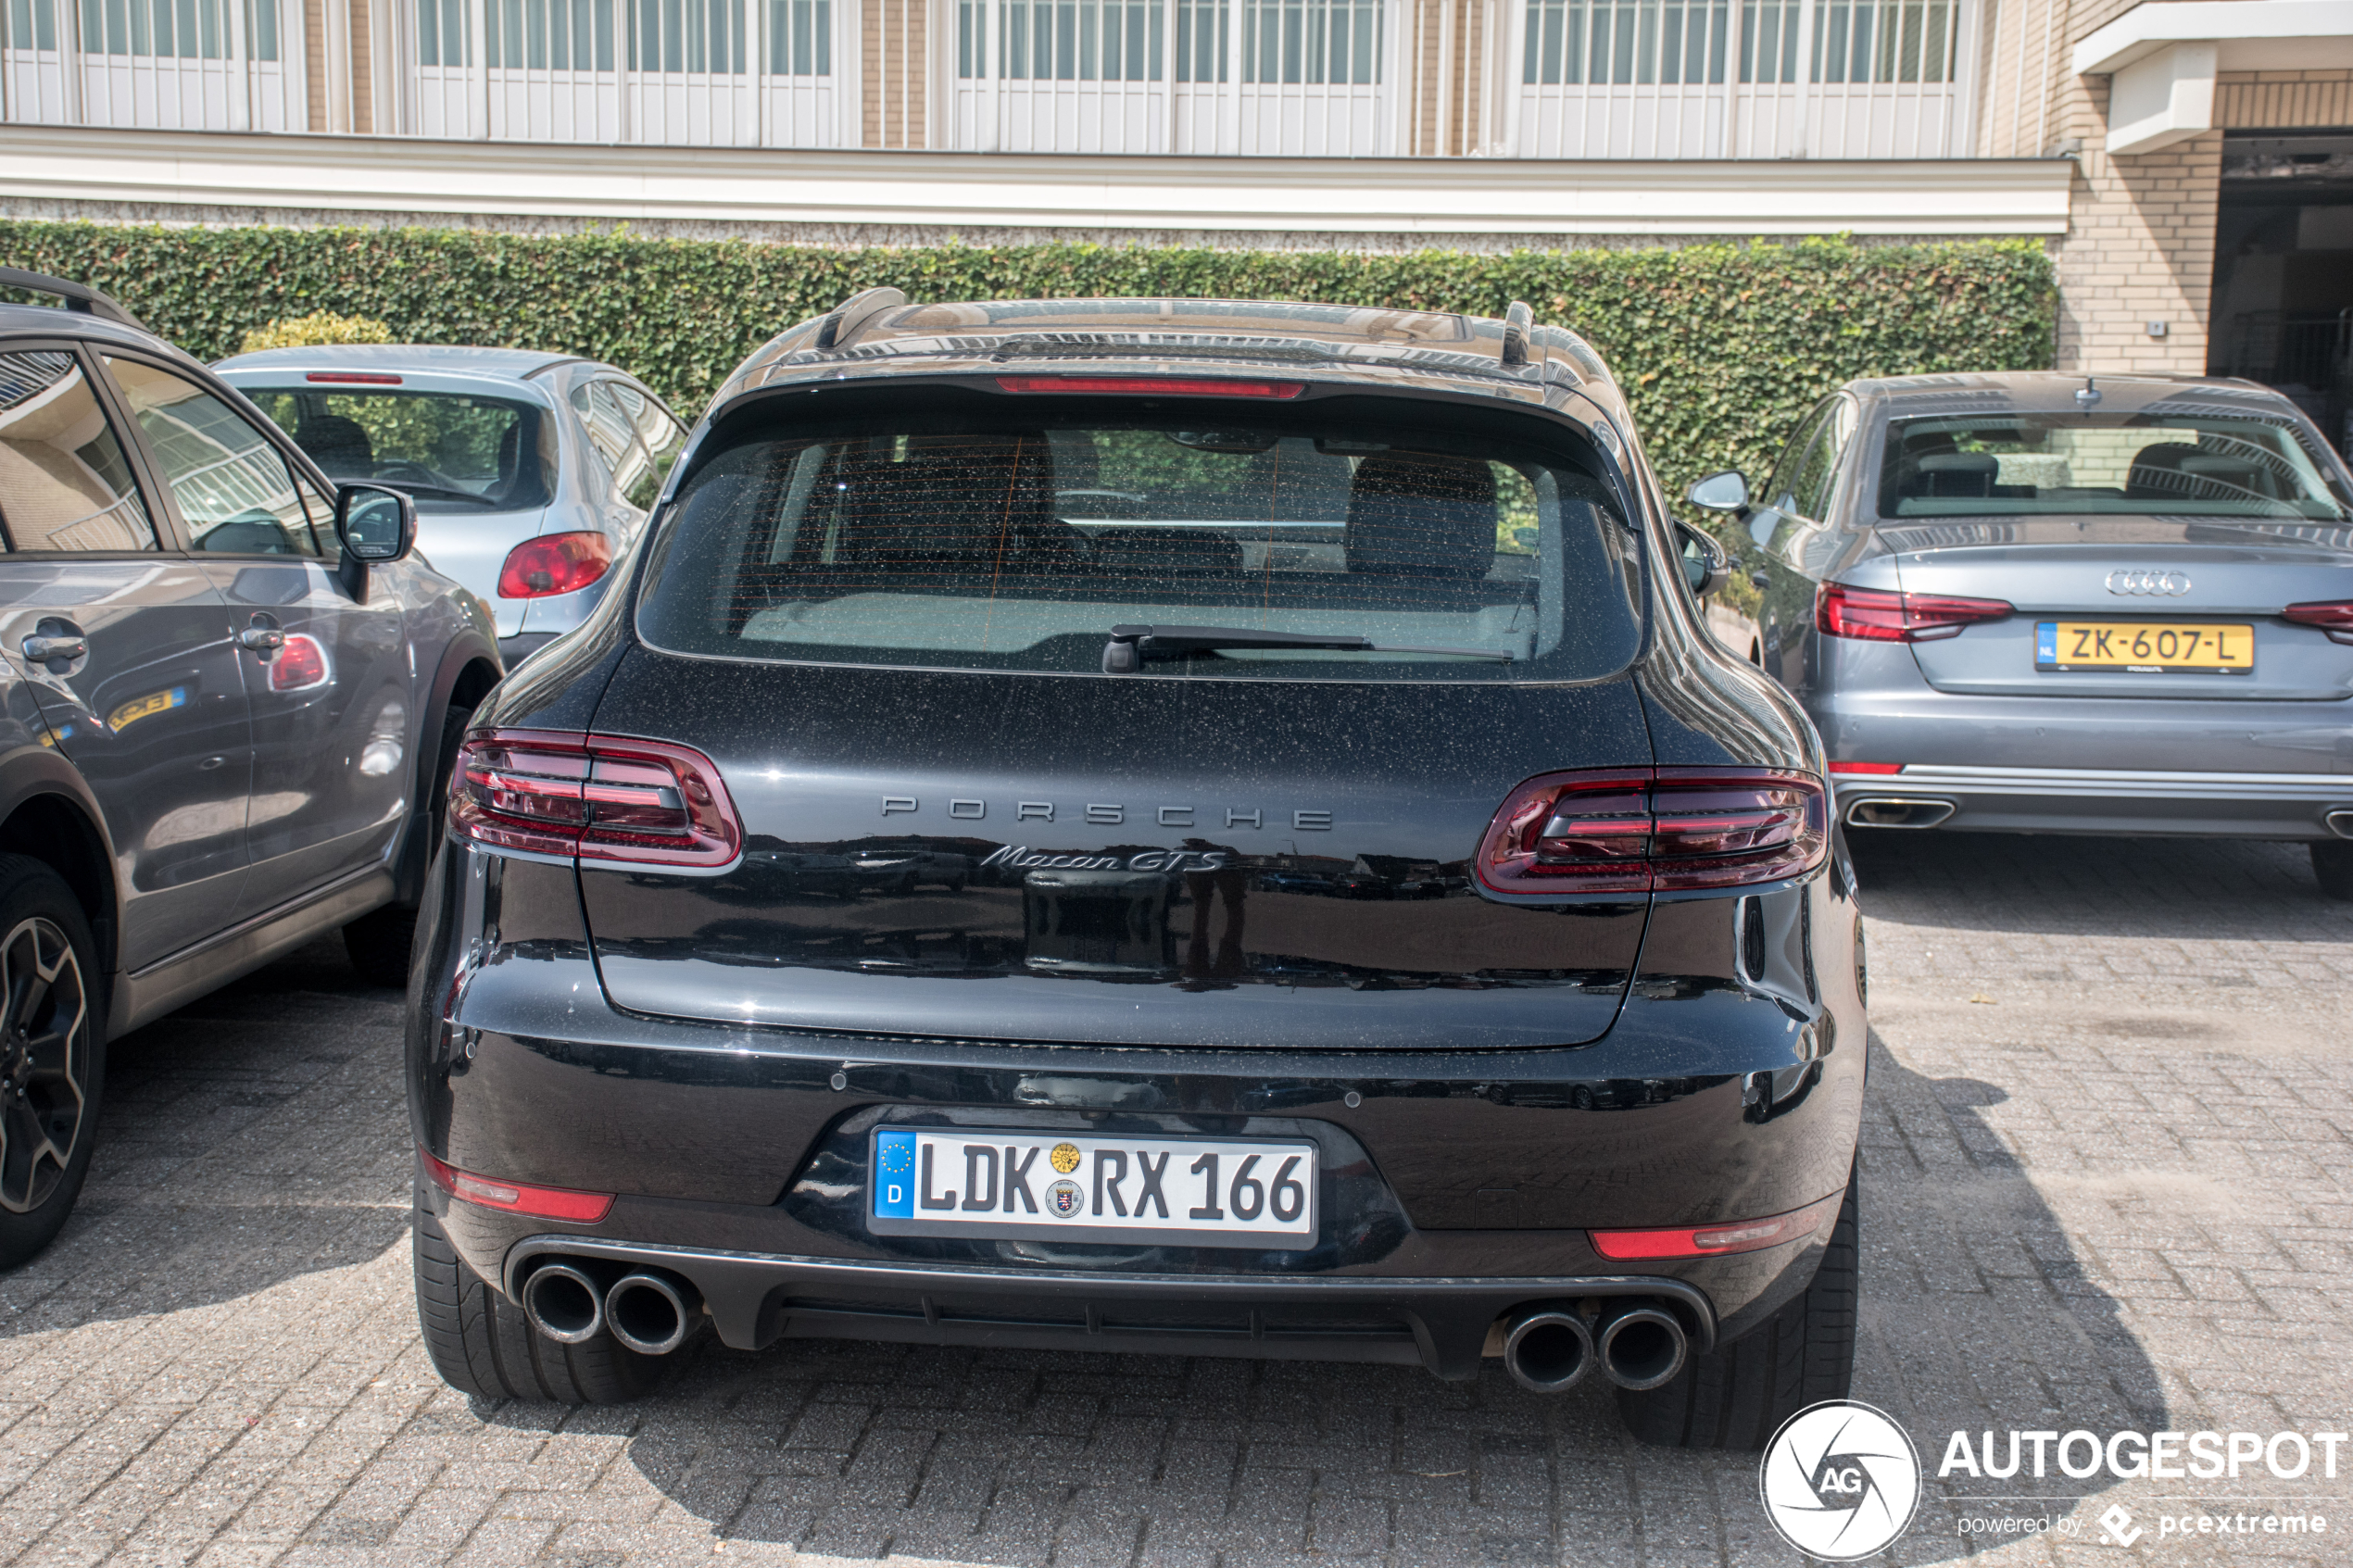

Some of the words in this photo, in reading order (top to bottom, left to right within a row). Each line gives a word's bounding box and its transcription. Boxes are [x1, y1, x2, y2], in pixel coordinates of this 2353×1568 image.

[2039, 646, 2056, 657] NL
[2071, 629, 2235, 659] ZK-607-L
[881, 796, 1332, 830] PORSCHE
[980, 846, 1120, 870] Macan
[1128, 851, 1227, 872] GTS
[887, 1184, 902, 1204] D
[920, 1143, 1040, 1213] LDK
[1091, 1149, 1170, 1219] RX
[1189, 1153, 1304, 1222] 166
